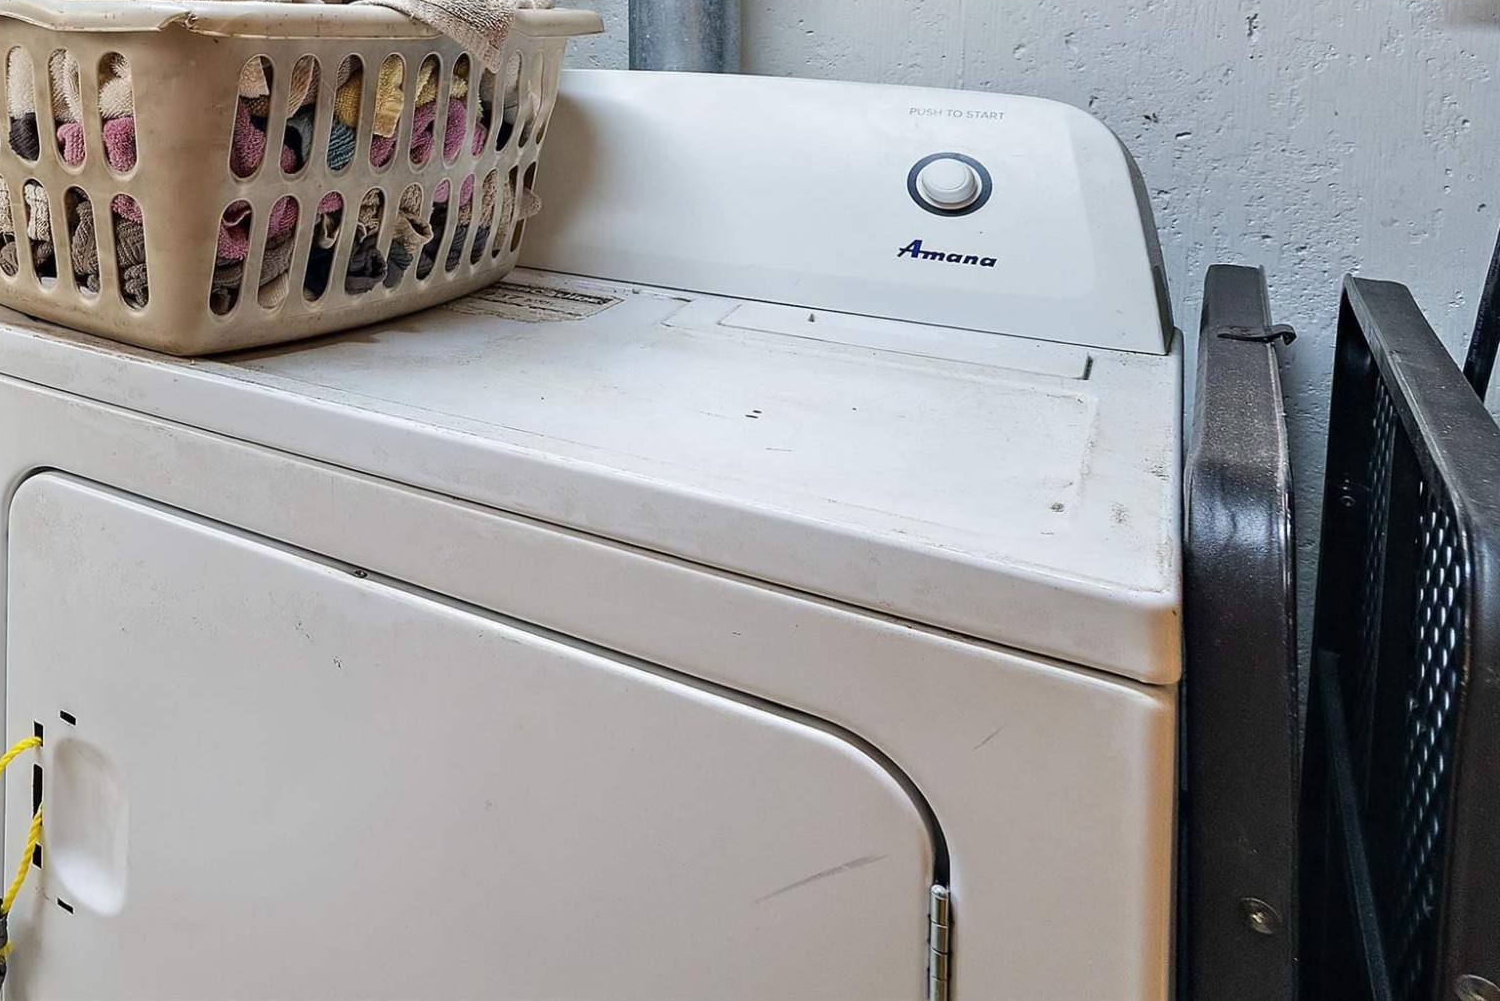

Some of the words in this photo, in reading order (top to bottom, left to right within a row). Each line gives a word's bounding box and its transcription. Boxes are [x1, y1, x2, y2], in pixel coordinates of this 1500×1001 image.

[909, 107, 942, 116] PUSH
[946, 109, 963, 118] TO
[966, 110, 1006, 120] START
[897, 239, 998, 267] Amana
